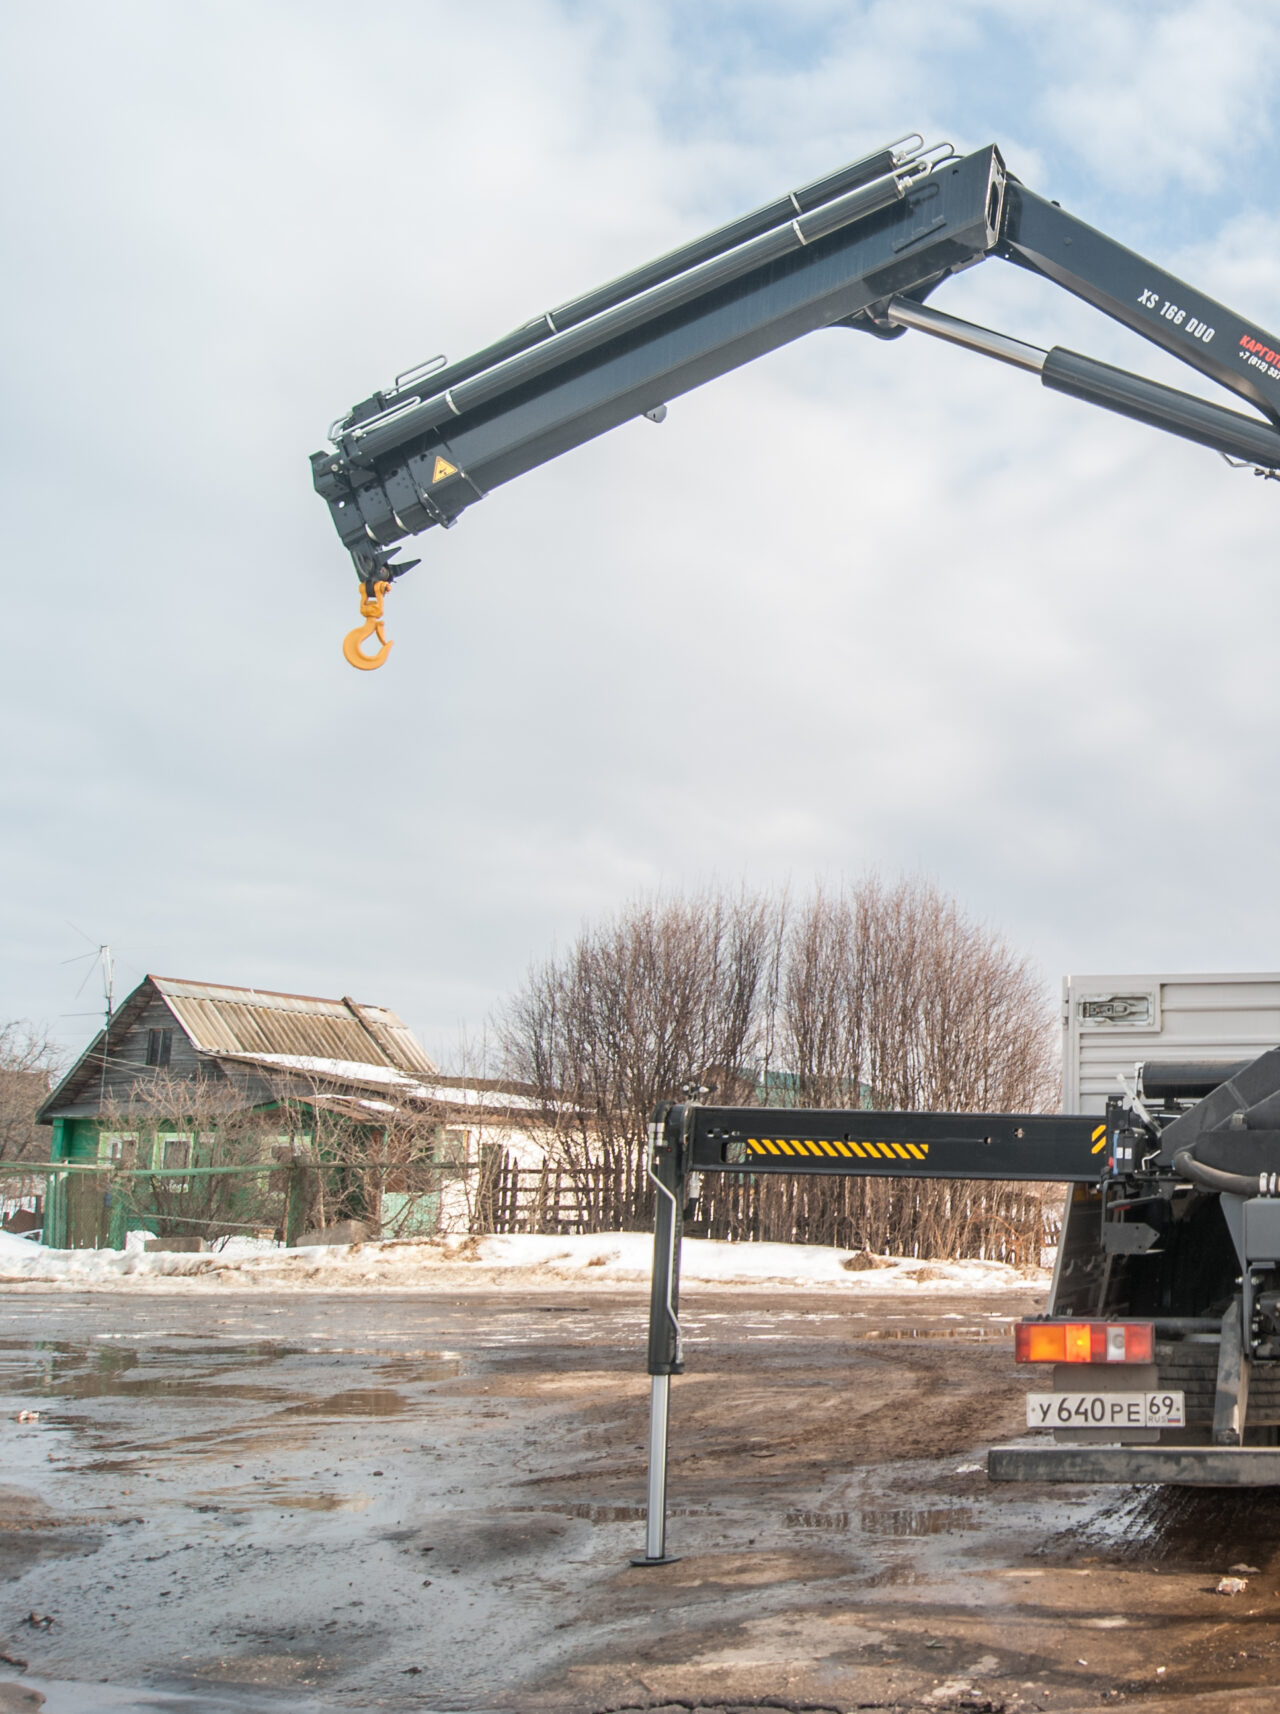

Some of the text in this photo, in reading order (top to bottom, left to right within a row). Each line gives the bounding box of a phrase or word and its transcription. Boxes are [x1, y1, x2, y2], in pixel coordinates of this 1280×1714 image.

[1137, 288, 1216, 343] XS 166 DUO
[1149, 1395, 1174, 1415] 69
[1148, 1415, 1167, 1423] RUS
